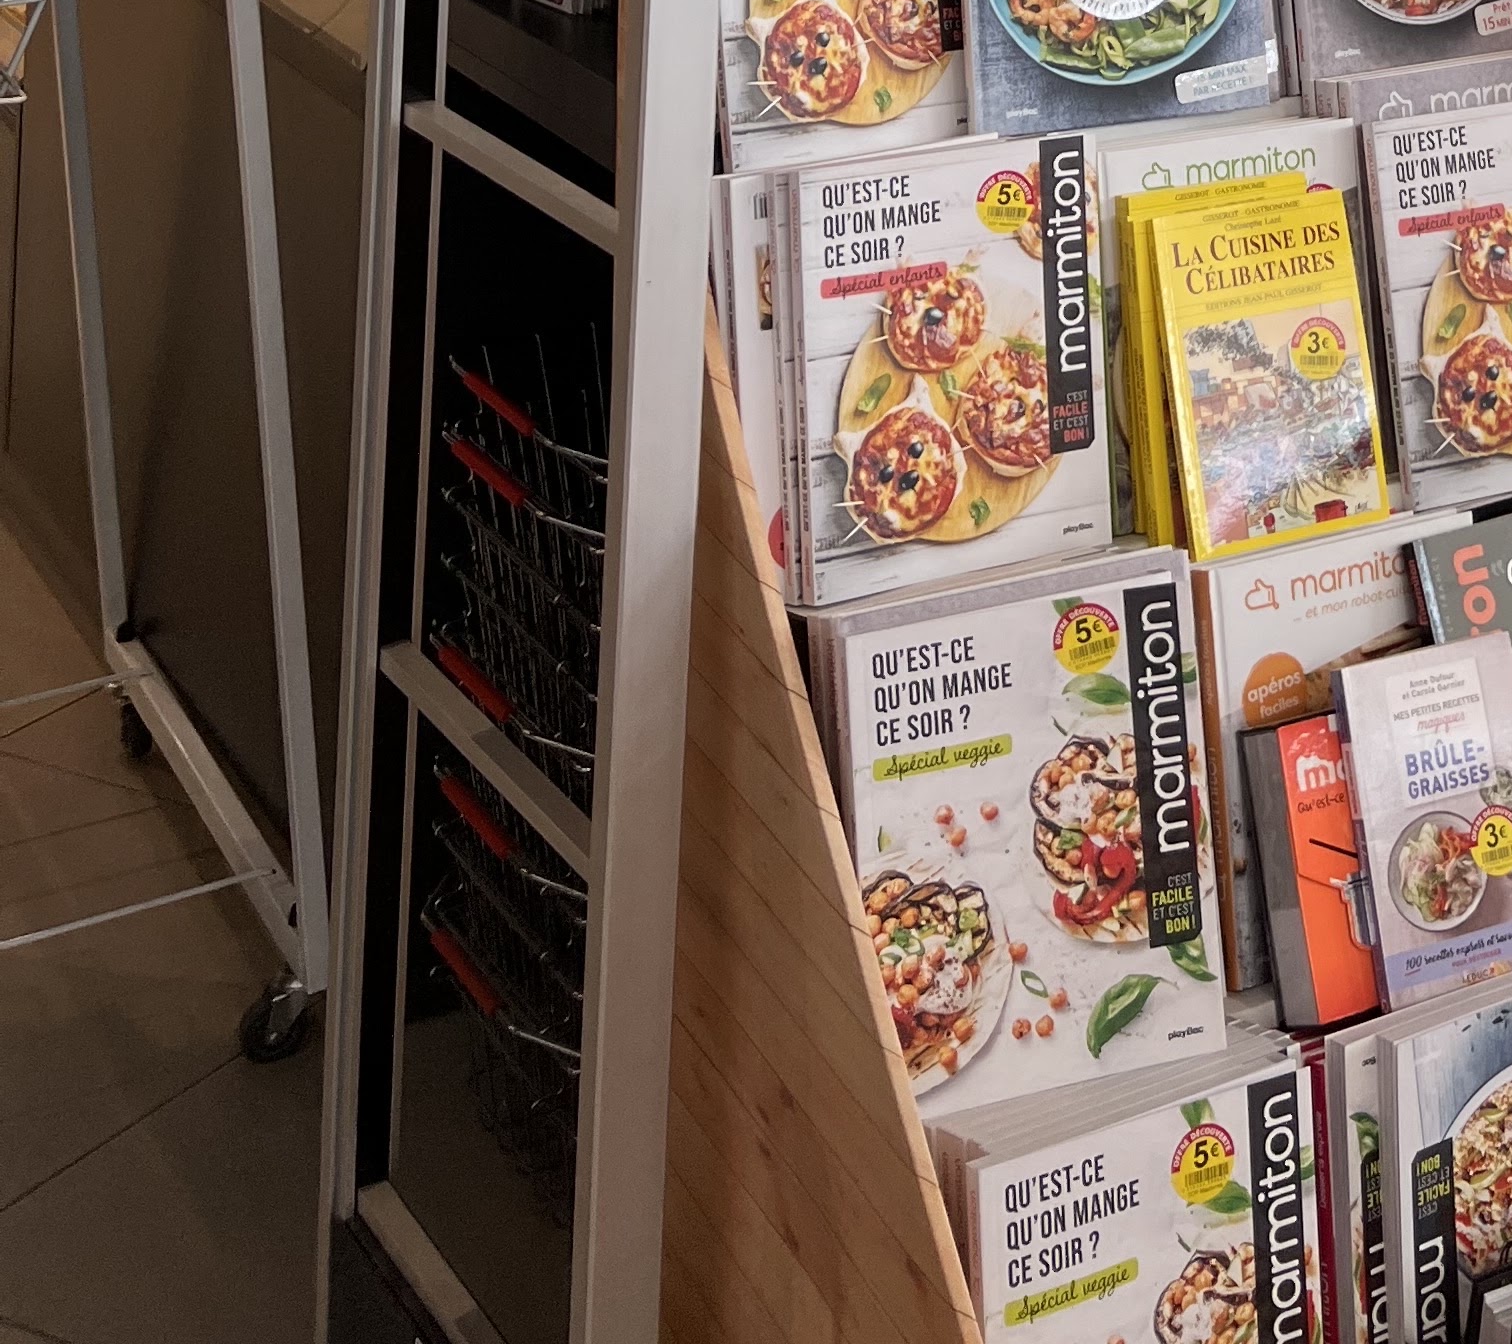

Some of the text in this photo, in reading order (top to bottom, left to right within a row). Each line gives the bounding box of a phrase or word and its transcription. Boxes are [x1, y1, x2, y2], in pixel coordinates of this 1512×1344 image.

[1392, 124, 1468, 158] QU'EST-CE
[1184, 145, 1317, 185] marmiton
[1394, 148, 1497, 186] QU'ON MANGE
[821, 175, 910, 210] QU'EST-CE
[1397, 182, 1456, 210] CE SOIR
[822, 200, 941, 241] QU'ON MANGE
[1405, 205, 1505, 235] Spécial enfants
[824, 239, 890, 269] CE SOIR
[1046, 150, 1088, 374] marmiton
[1170, 219, 1341, 269] LA CUISINE DES
[829, 264, 945, 297] Spécial enfants
[1185, 249, 1336, 296] CÉLIBATAIRES
[1052, 401, 1088, 419] FACILE
[1066, 389, 1088, 403] C'EST
[1066, 415, 1089, 429] C'EST
[1290, 551, 1404, 601] marmito
[1320, 600, 1348, 616] mon
[871, 635, 975, 680] QU'EST-CE
[873, 661, 1013, 714] QU'ON MANGE
[1247, 669, 1301, 704] apéros
[1259, 694, 1300, 719] faciles
[1393, 693, 1481, 722] MES PETITES RECETTES
[875, 710, 954, 747] CE SOIR
[1136, 599, 1191, 854] marmiton
[882, 738, 1005, 778] Spécial veggie
[1404, 738, 1486, 778] BRÛLE-
[1408, 762, 1491, 801] GRAISSES
[1296, 792, 1346, 813] Qu'est-ce
[1151, 884, 1195, 907] FACILE
[1166, 871, 1193, 888] C'EST
[1151, 900, 1196, 921] ET C'EST
[1165, 914, 1190, 934] BON
[1405, 954, 1422, 971] 100
[1003, 1153, 1106, 1214] QU'EST-CE
[1006, 1179, 1140, 1252] QU'ON MANGE
[1257, 1090, 1303, 1344] marmiton
[1007, 1237, 1084, 1289] CE SOIR
[1014, 1263, 1131, 1323] Spécial veggie
